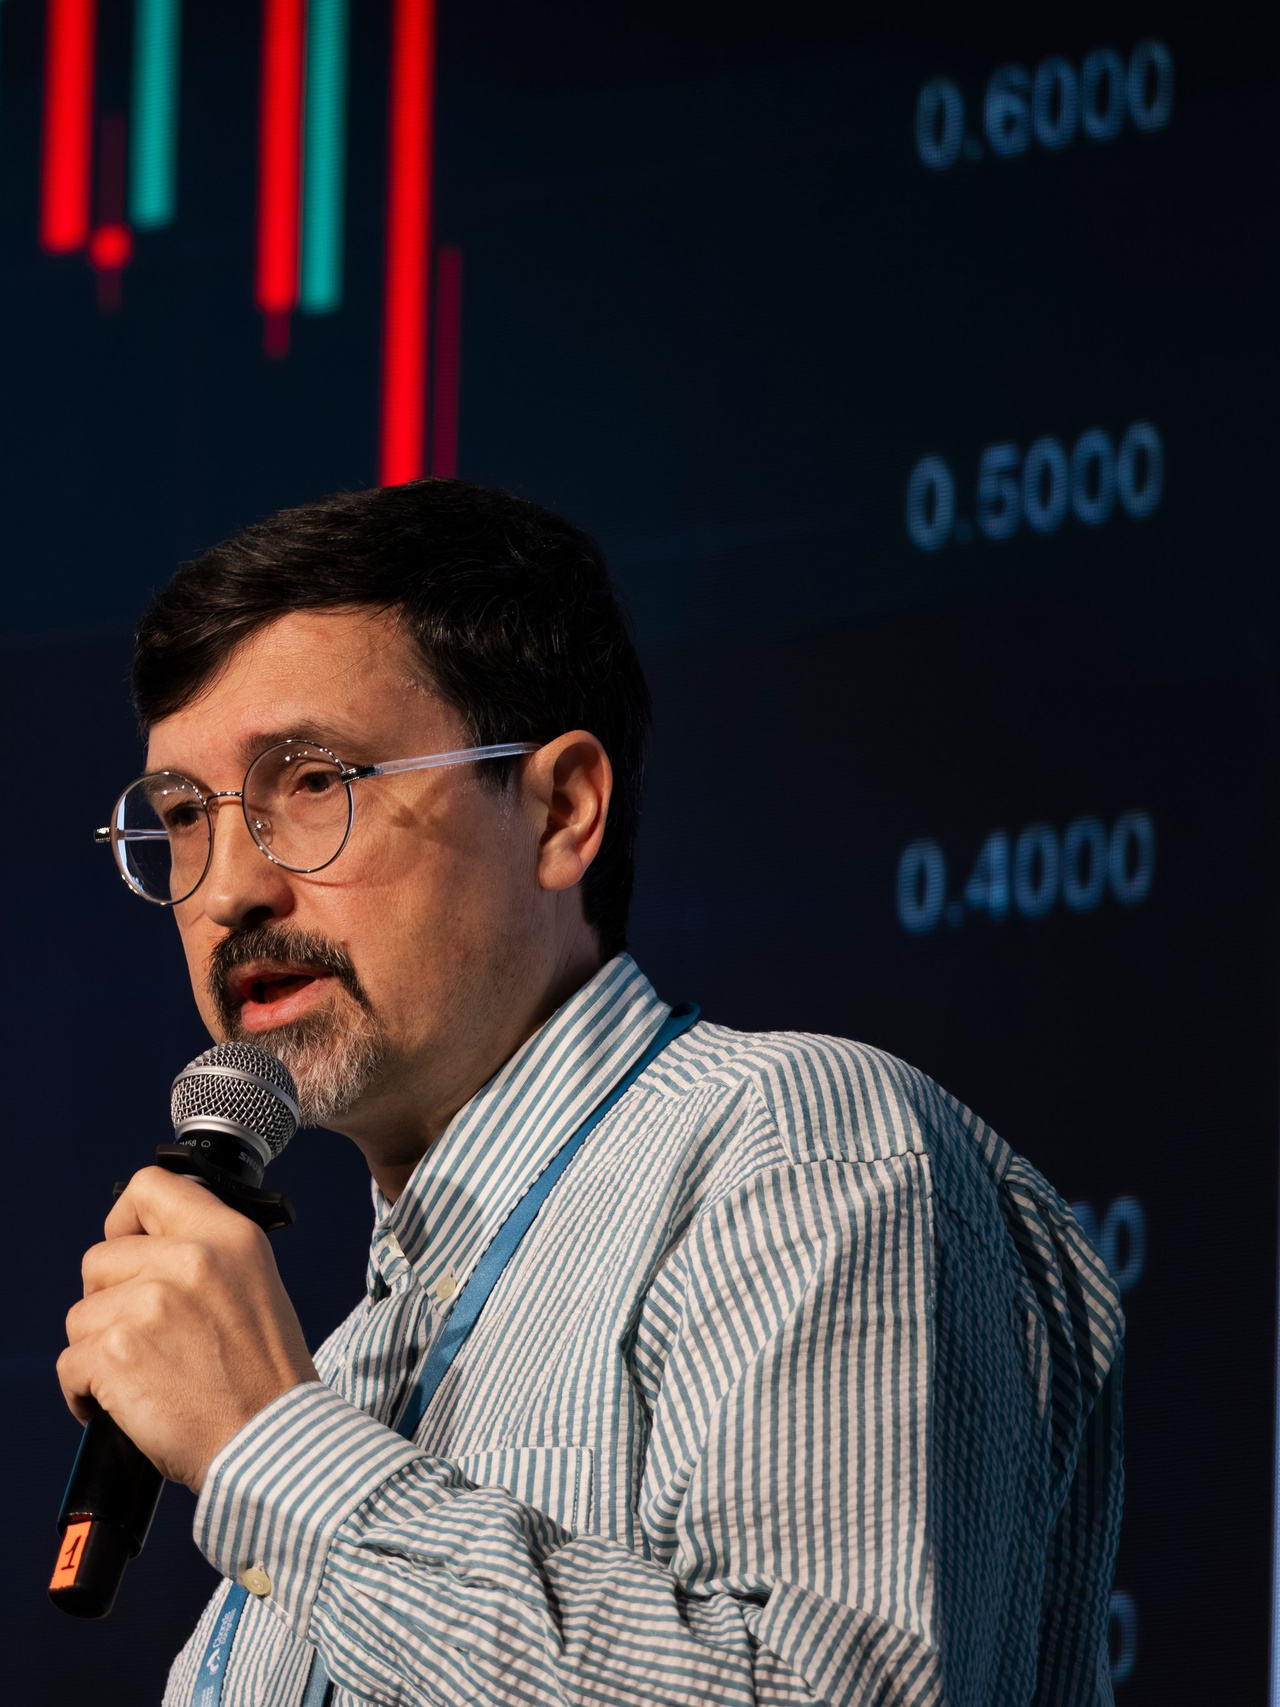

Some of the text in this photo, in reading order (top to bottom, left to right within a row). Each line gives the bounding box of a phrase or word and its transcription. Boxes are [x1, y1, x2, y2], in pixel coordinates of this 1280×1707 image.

[916, 40, 1174, 171] 0.6000
[906, 421, 1163, 552] 0.5000
[897, 812, 1154, 934] 0.4000
[61, 1535, 82, 1571] 1
